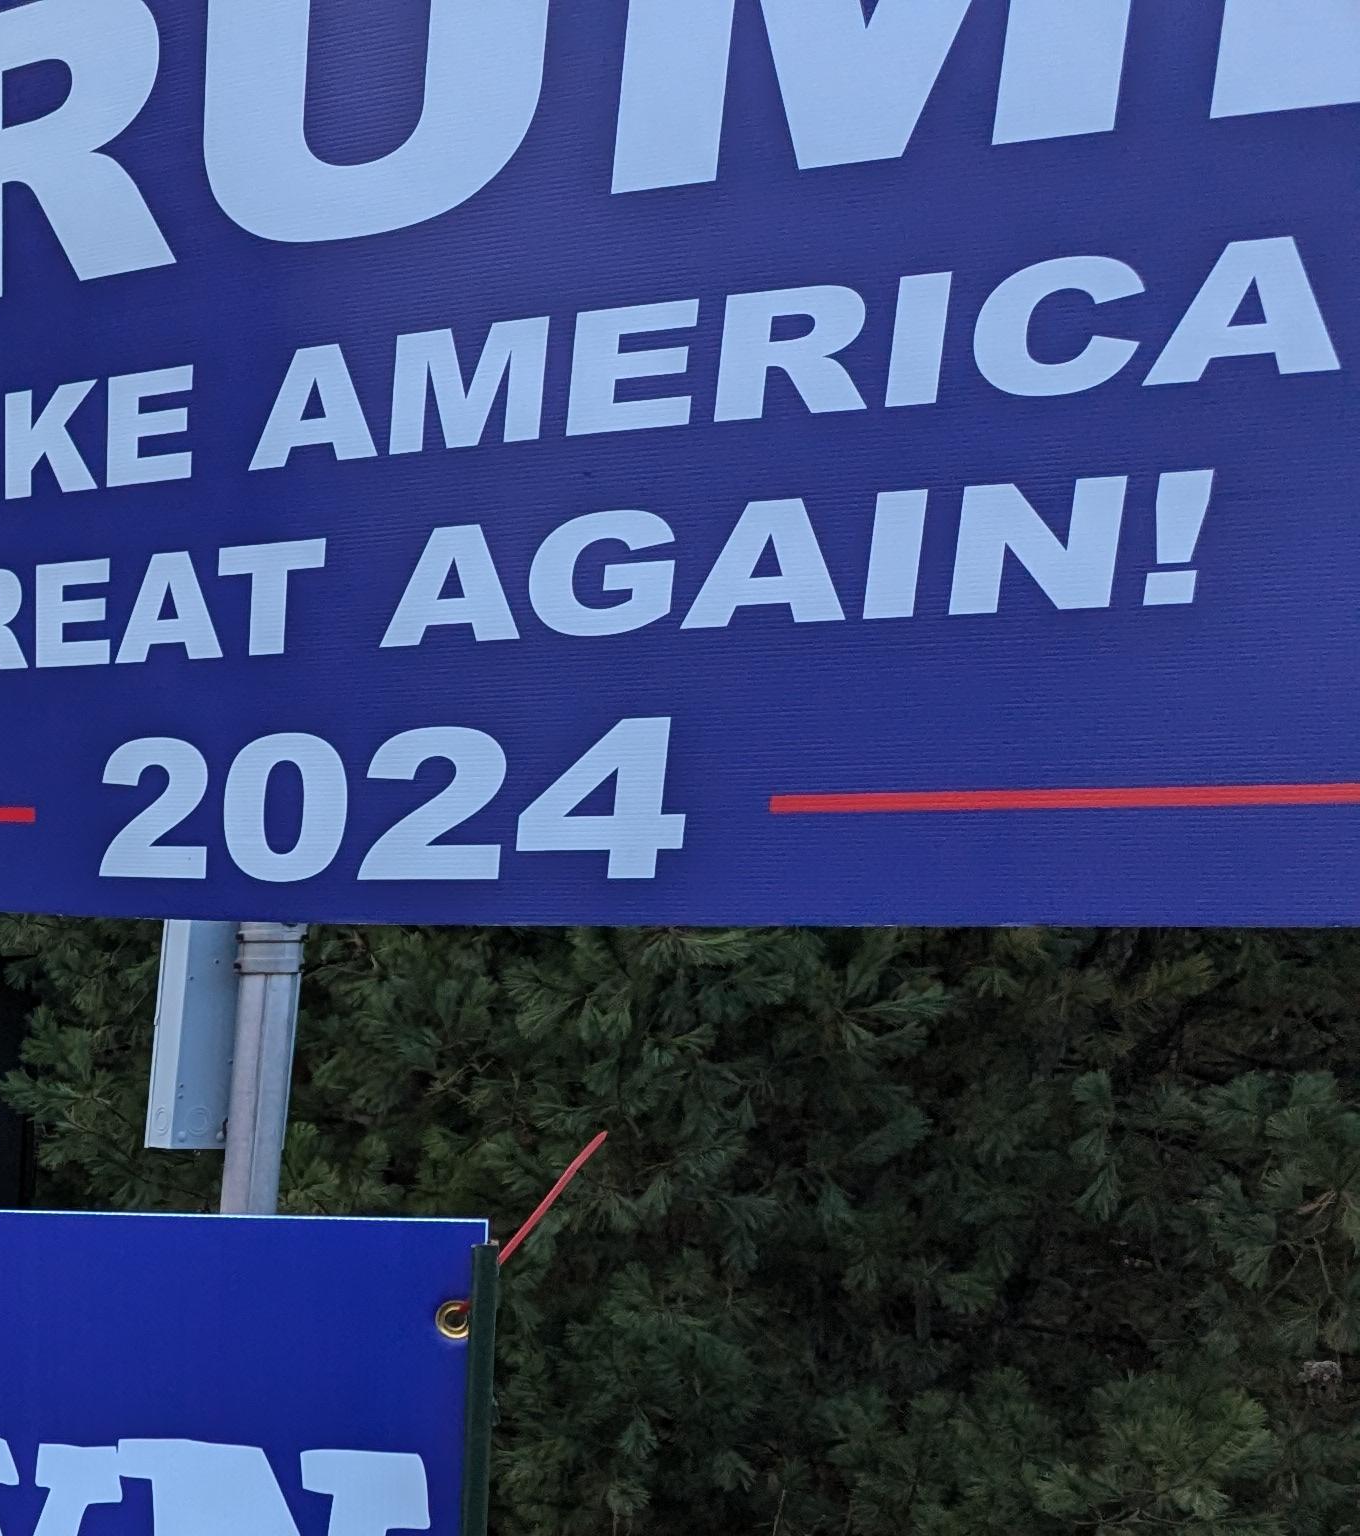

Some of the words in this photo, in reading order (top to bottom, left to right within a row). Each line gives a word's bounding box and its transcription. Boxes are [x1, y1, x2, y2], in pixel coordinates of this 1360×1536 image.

[249, 236, 1341, 472] AMERICA
[380, 469, 1214, 649] AGAIN!
[99, 717, 686, 882] 2024
